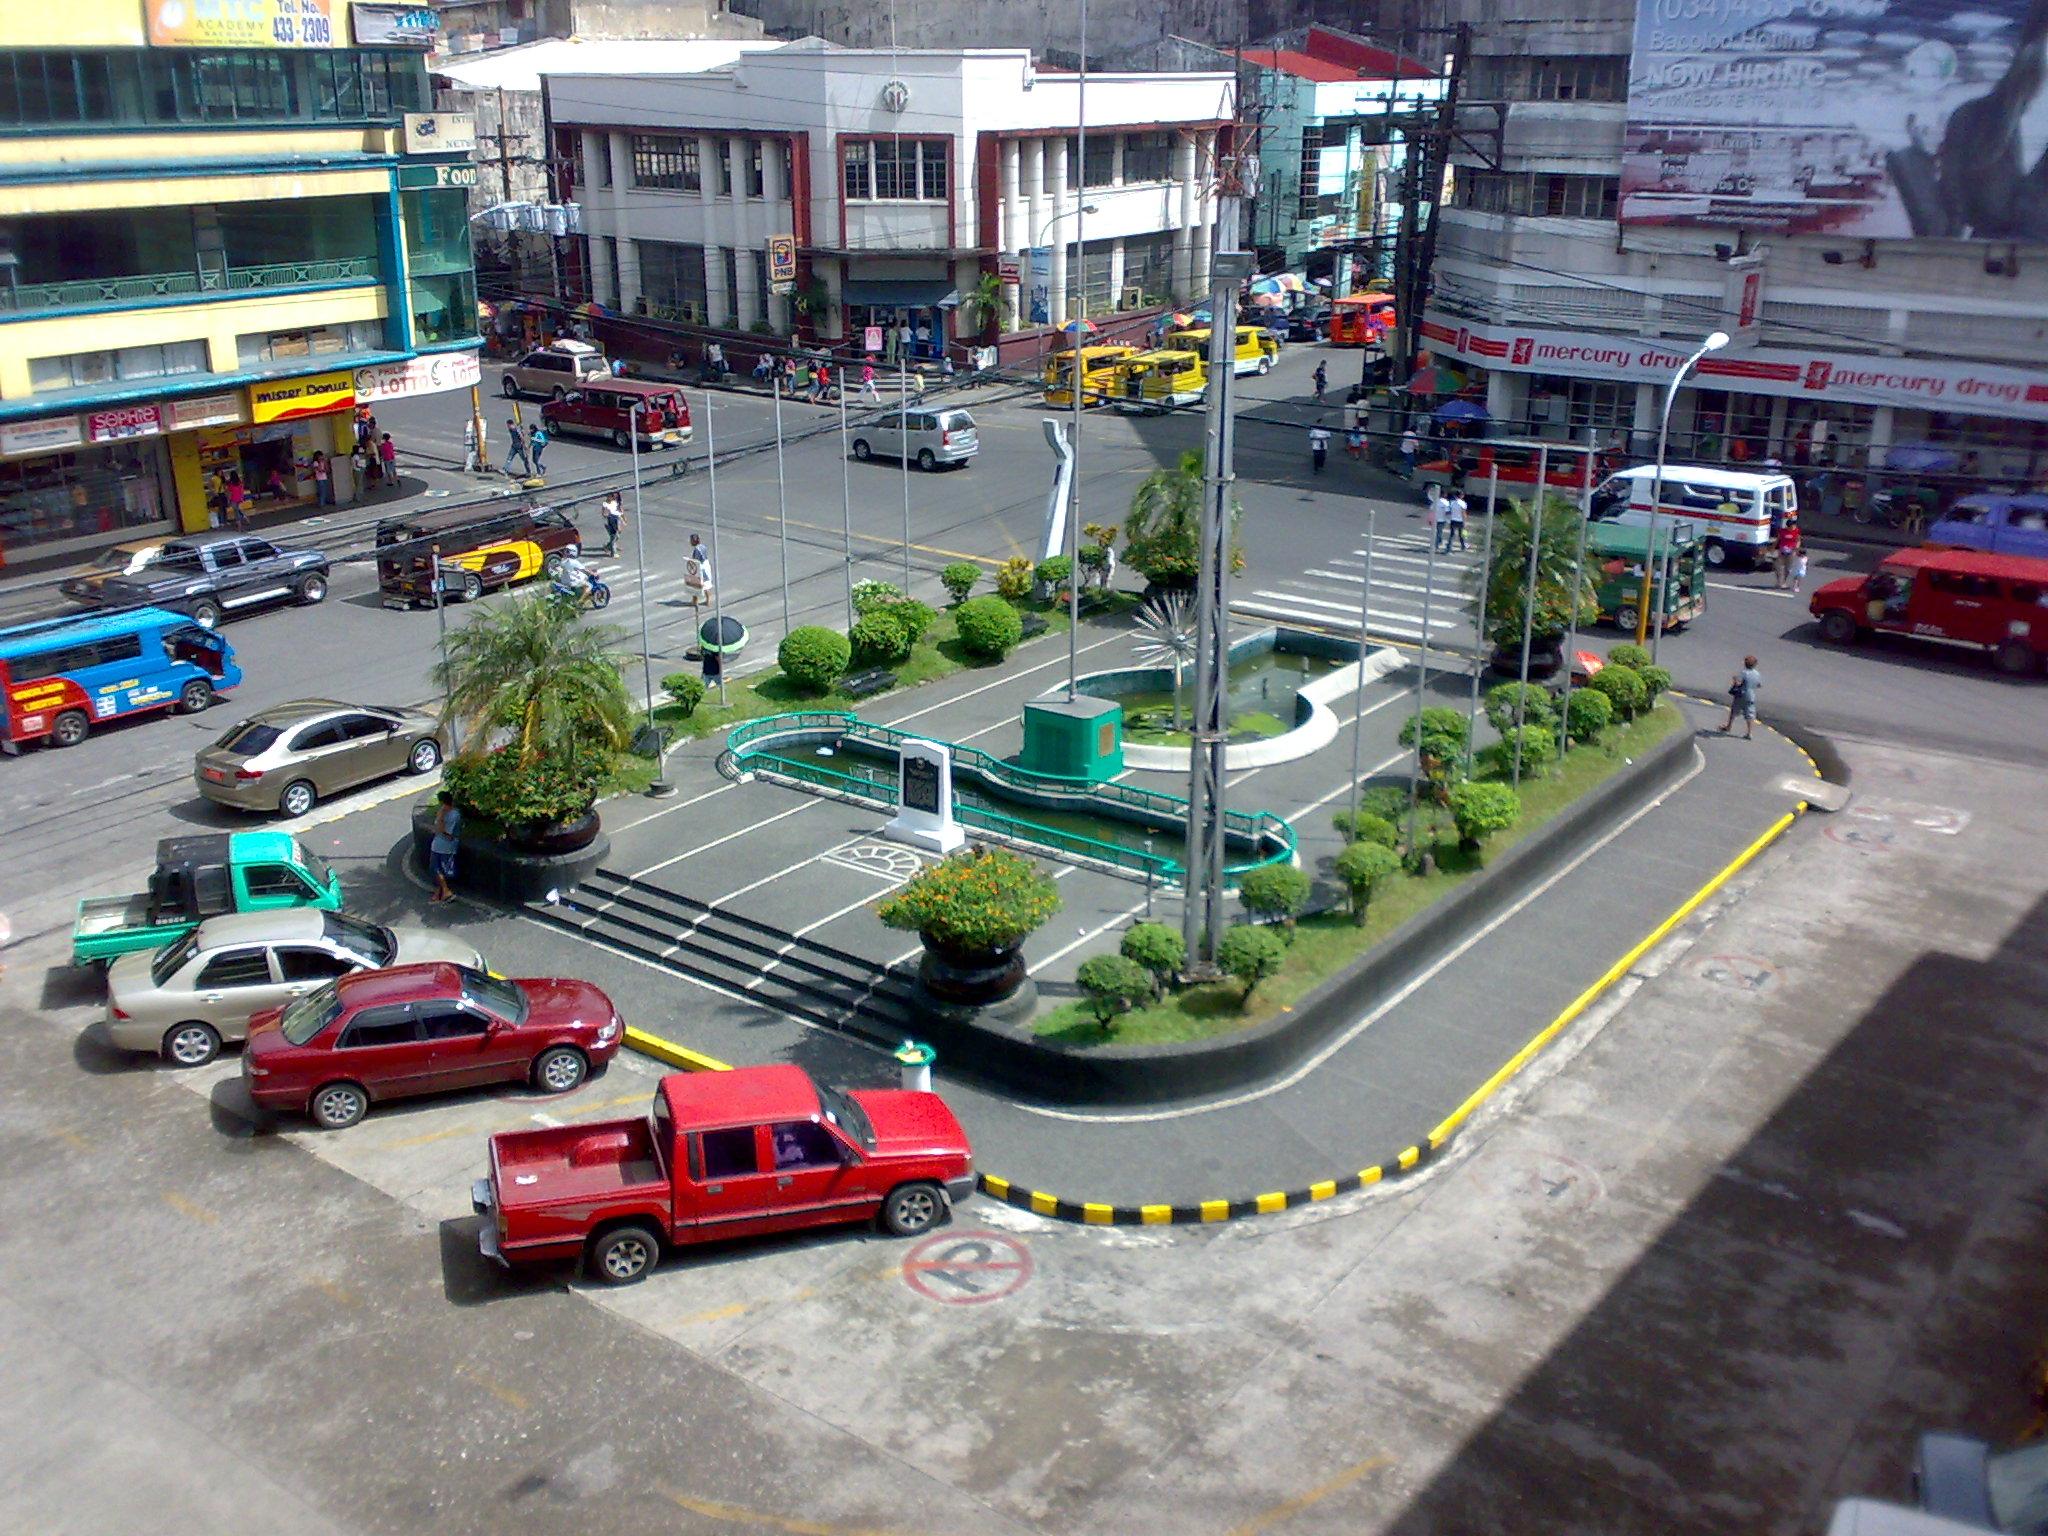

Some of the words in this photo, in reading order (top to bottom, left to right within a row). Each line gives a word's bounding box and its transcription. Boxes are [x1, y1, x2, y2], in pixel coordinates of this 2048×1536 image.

[196, 19, 265, 31] ACADEMY
[1645, 61, 1716, 91] NOW
[774, 266, 794, 278] PNB
[1537, 343, 1630, 369] mercury
[380, 374, 429, 395] LOTTO
[1834, 368, 1947, 396] mercury
[1956, 378, 2020, 401] drug
